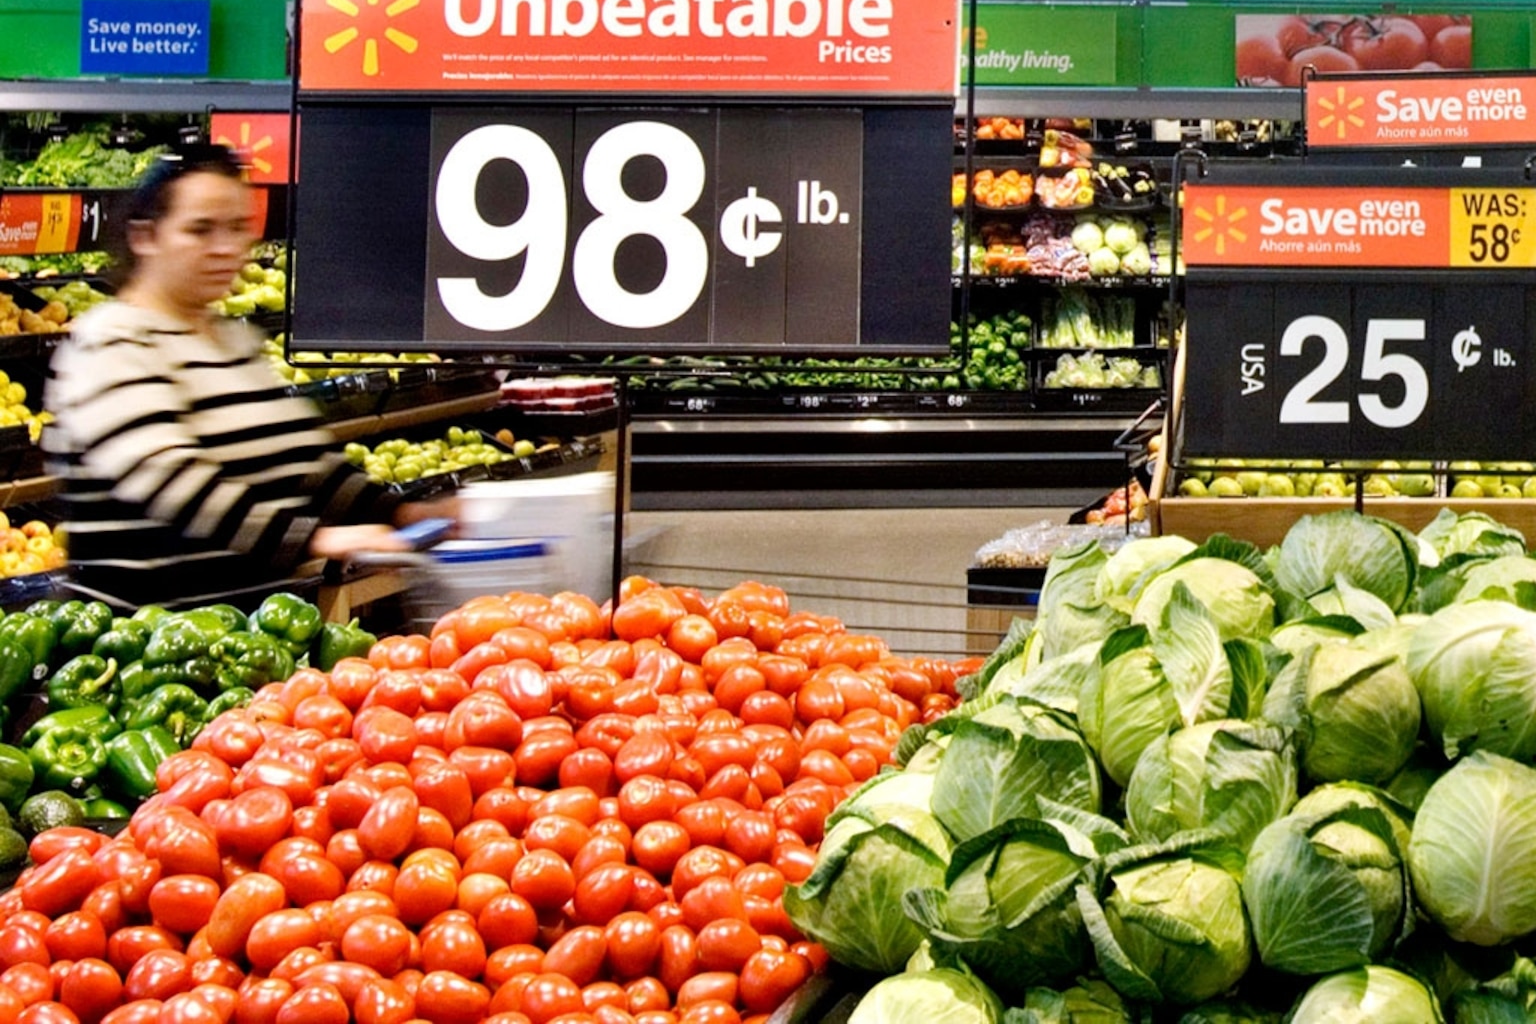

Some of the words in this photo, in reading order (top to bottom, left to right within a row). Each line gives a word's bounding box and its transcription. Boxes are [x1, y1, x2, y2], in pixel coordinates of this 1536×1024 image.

[88, 19, 131, 34] Save
[136, 21, 201, 38] money.
[90, 38, 128, 53] Live
[133, 38, 195, 53] better.
[818, 40, 892, 63] Prices
[458, 54, 477, 63] match
[478, 54, 488, 63] the
[489, 54, 504, 63] price
[1022, 50, 1074, 73] living.
[1376, 91, 1463, 122] Save
[1467, 87, 1521, 104] even
[1467, 104, 1527, 122] more
[1376, 126, 1416, 139] Ahorre
[1419, 125, 1441, 138] aún
[1444, 124, 1469, 138] más
[1463, 193, 1527, 218] WAS:
[435, 121, 709, 331] 98
[797, 180, 849, 224] lb.
[1260, 200, 1357, 235] Save
[1360, 199, 1420, 218] even
[1360, 218, 1426, 236] more
[1260, 239, 1306, 252] Ahorre
[1308, 239, 1334, 253] aún
[1336, 238, 1361, 253] más
[1241, 343, 1265, 396] USA
[1279, 315, 1430, 428] 25
[1493, 348, 1516, 367] lb.
